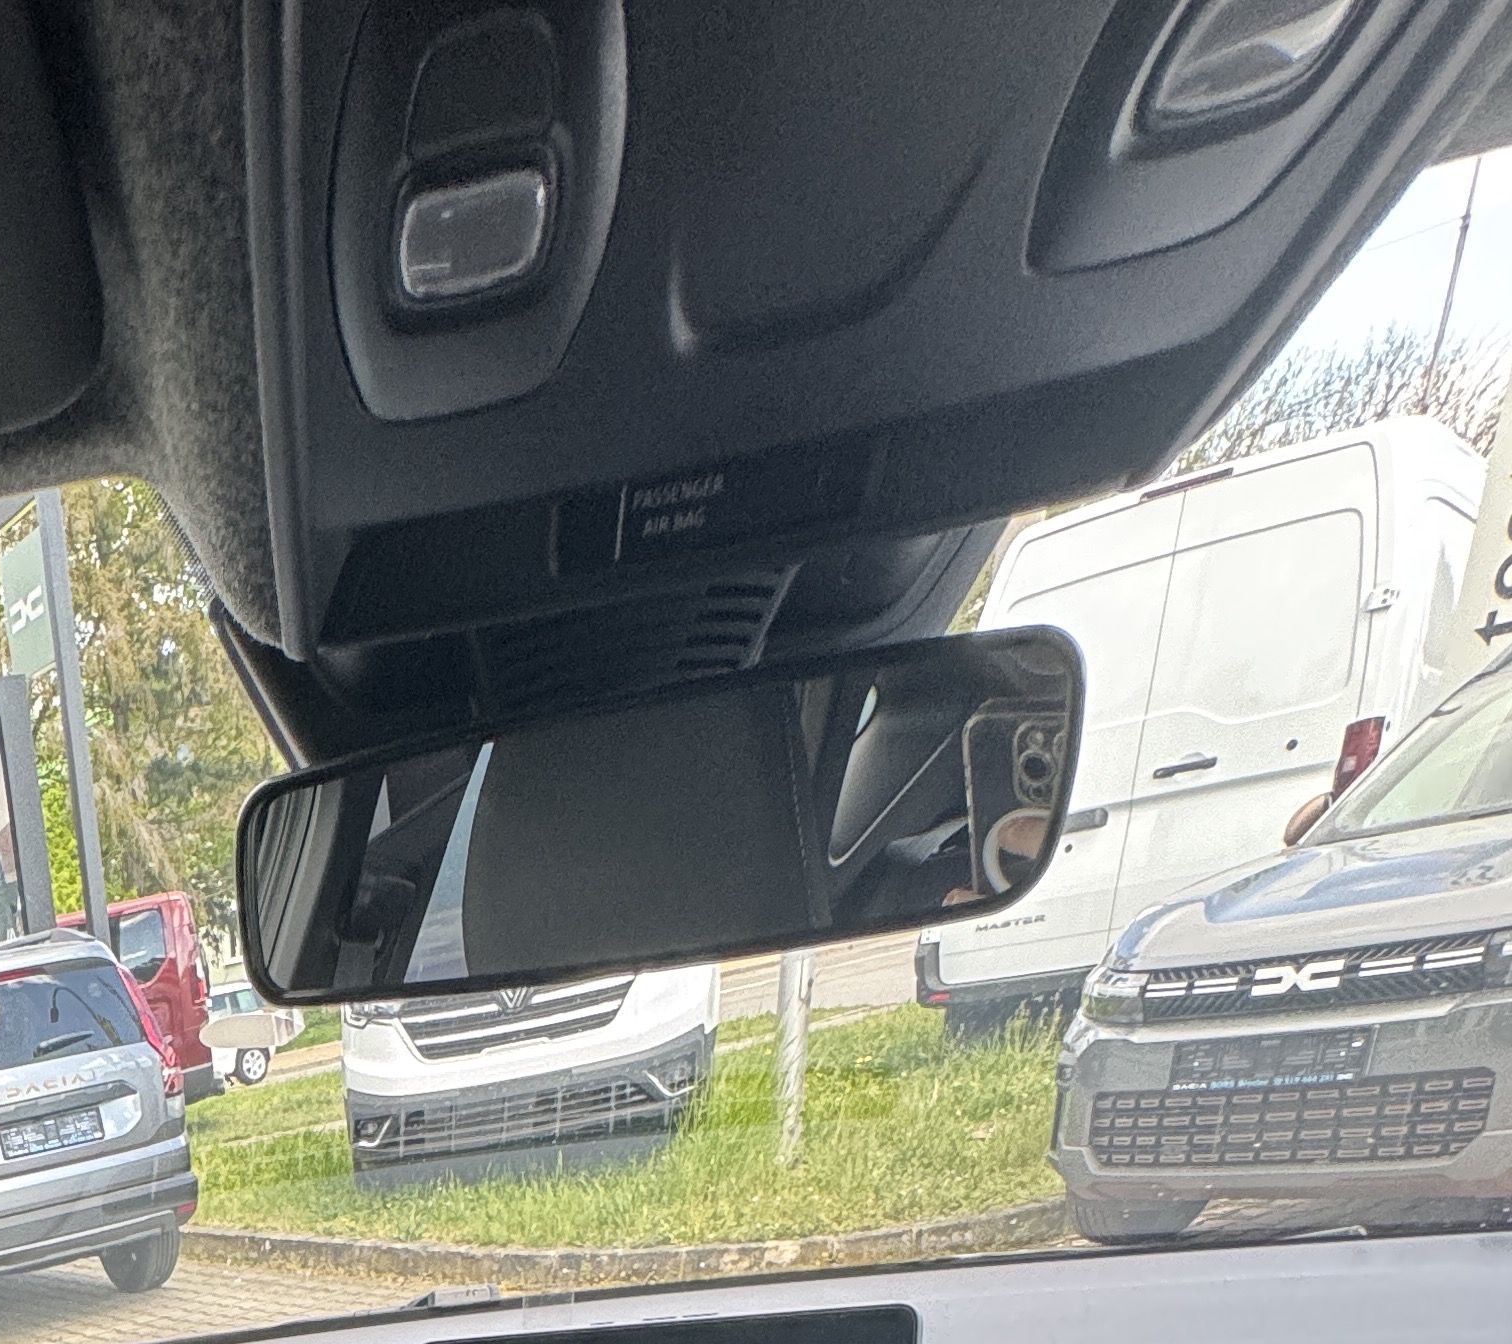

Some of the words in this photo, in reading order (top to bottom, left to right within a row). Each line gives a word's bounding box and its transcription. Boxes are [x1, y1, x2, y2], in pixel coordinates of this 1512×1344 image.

[632, 473, 727, 510] PASSENGER
[975, 914, 1047, 933] MASTER
[6, 1072, 87, 1099] DACIA
